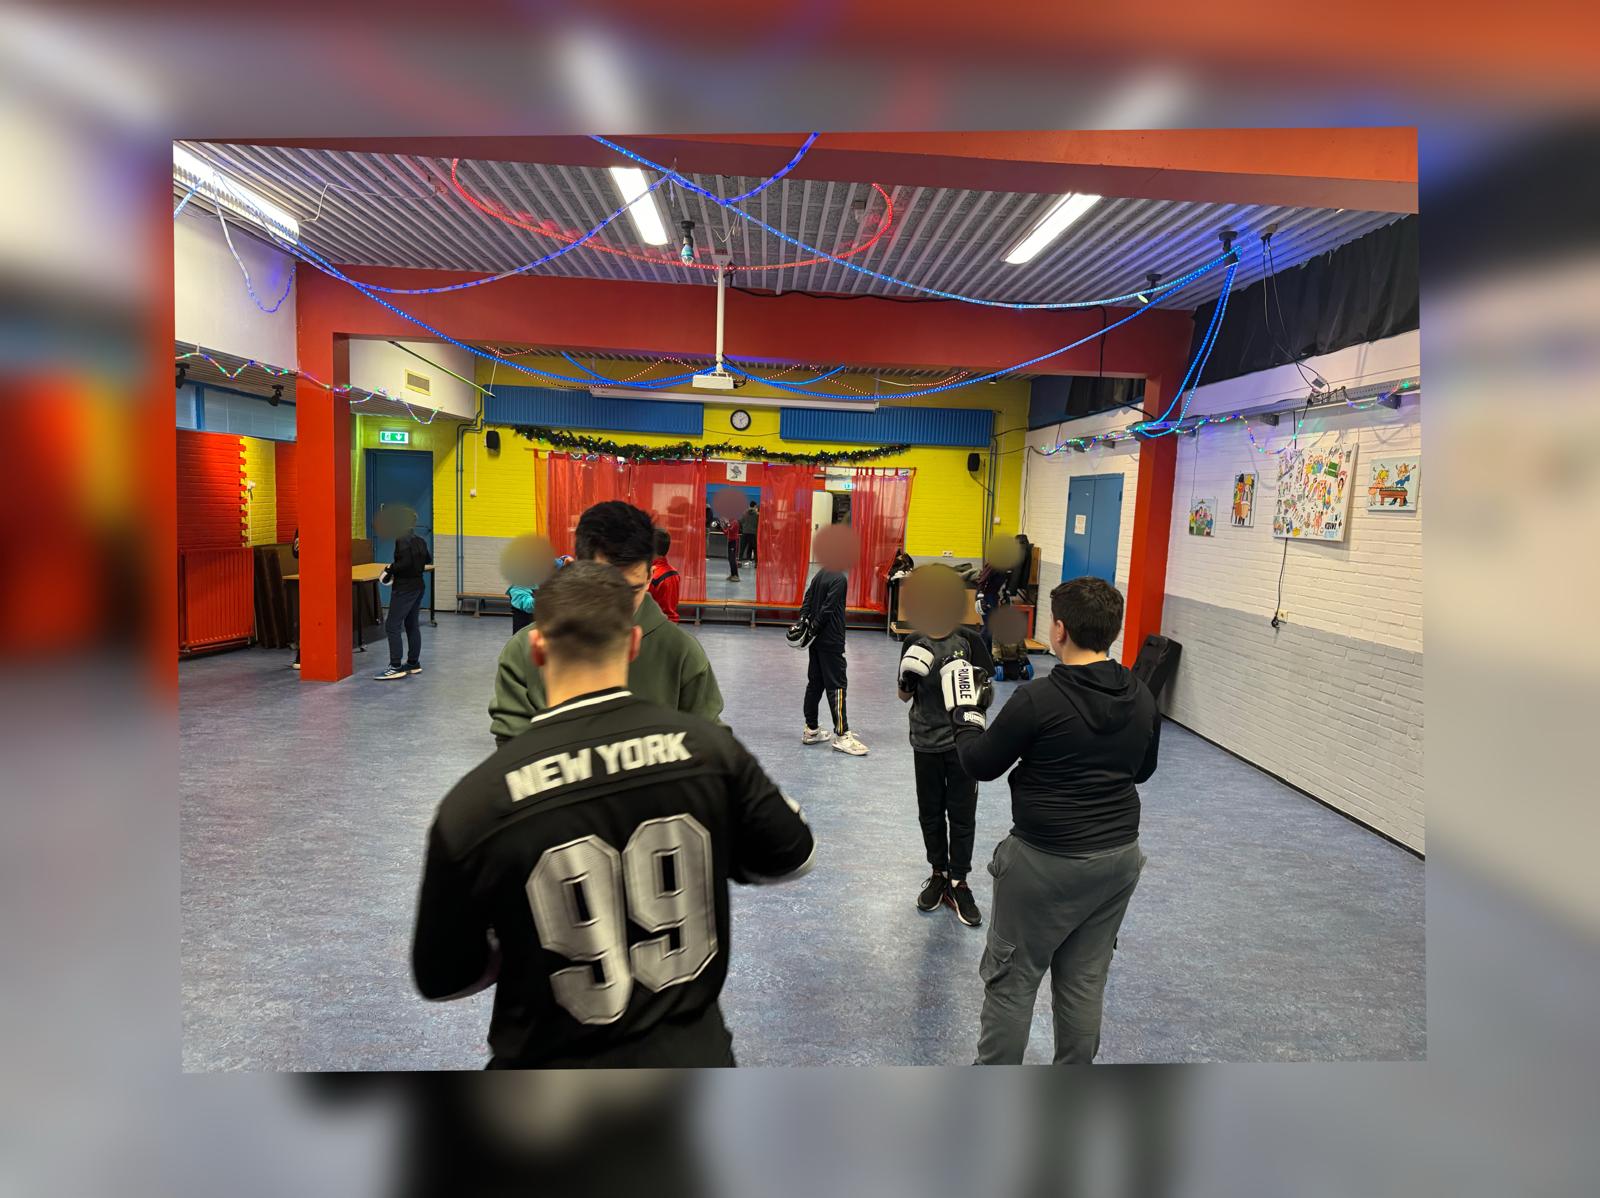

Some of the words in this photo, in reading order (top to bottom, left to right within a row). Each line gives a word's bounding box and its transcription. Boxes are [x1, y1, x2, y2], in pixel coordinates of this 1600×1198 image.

[958, 668, 972, 699] RUMBLE
[505, 748, 593, 802] NEW
[595, 731, 693, 775] YORK
[525, 812, 718, 1025] 99
